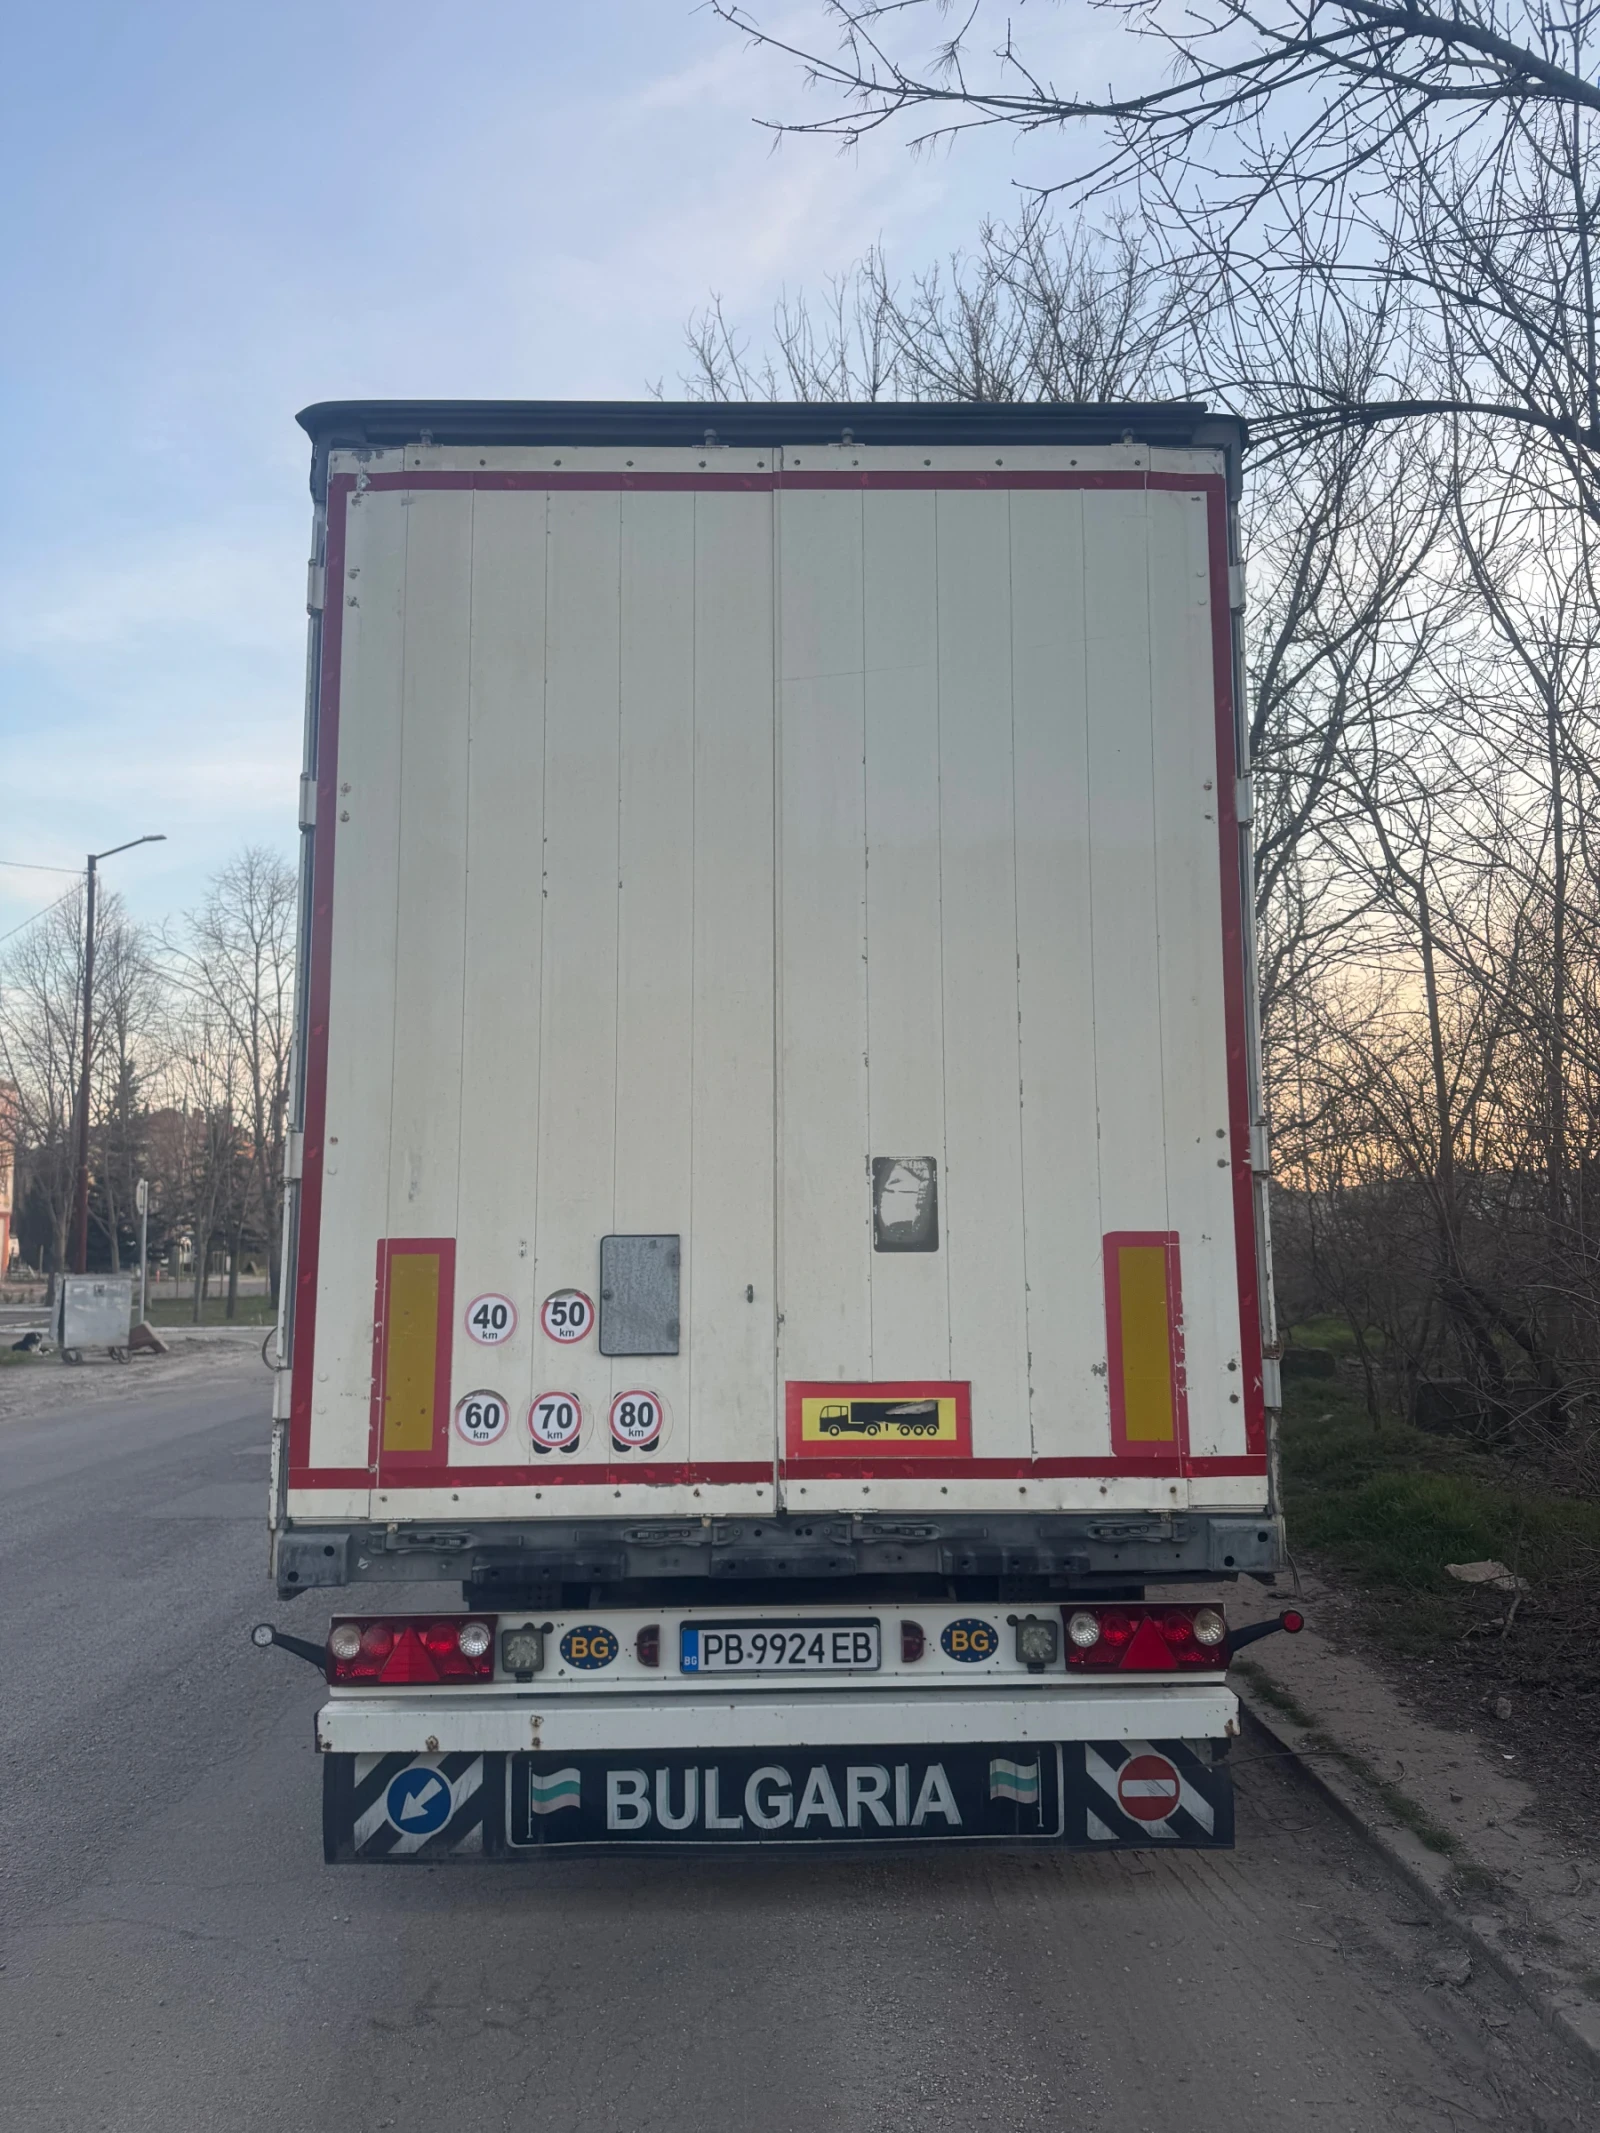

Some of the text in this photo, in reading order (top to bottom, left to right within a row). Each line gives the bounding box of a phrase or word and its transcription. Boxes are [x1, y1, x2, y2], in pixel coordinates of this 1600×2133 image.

[473, 1304, 507, 1329] 40
[551, 1301, 585, 1327] 50
[482, 1330, 498, 1340] km
[559, 1328, 575, 1337] km
[465, 1402, 500, 1429] 60
[538, 1403, 573, 1429] 70
[620, 1402, 654, 1428] 80
[473, 1430, 489, 1440] km
[547, 1429, 563, 1440] km
[628, 1428, 644, 1437] km
[571, 1636, 609, 1659] BG
[951, 1630, 989, 1652] BG
[684, 1656, 698, 1666] BG
[606, 1762, 963, 1830] BULGARIA
